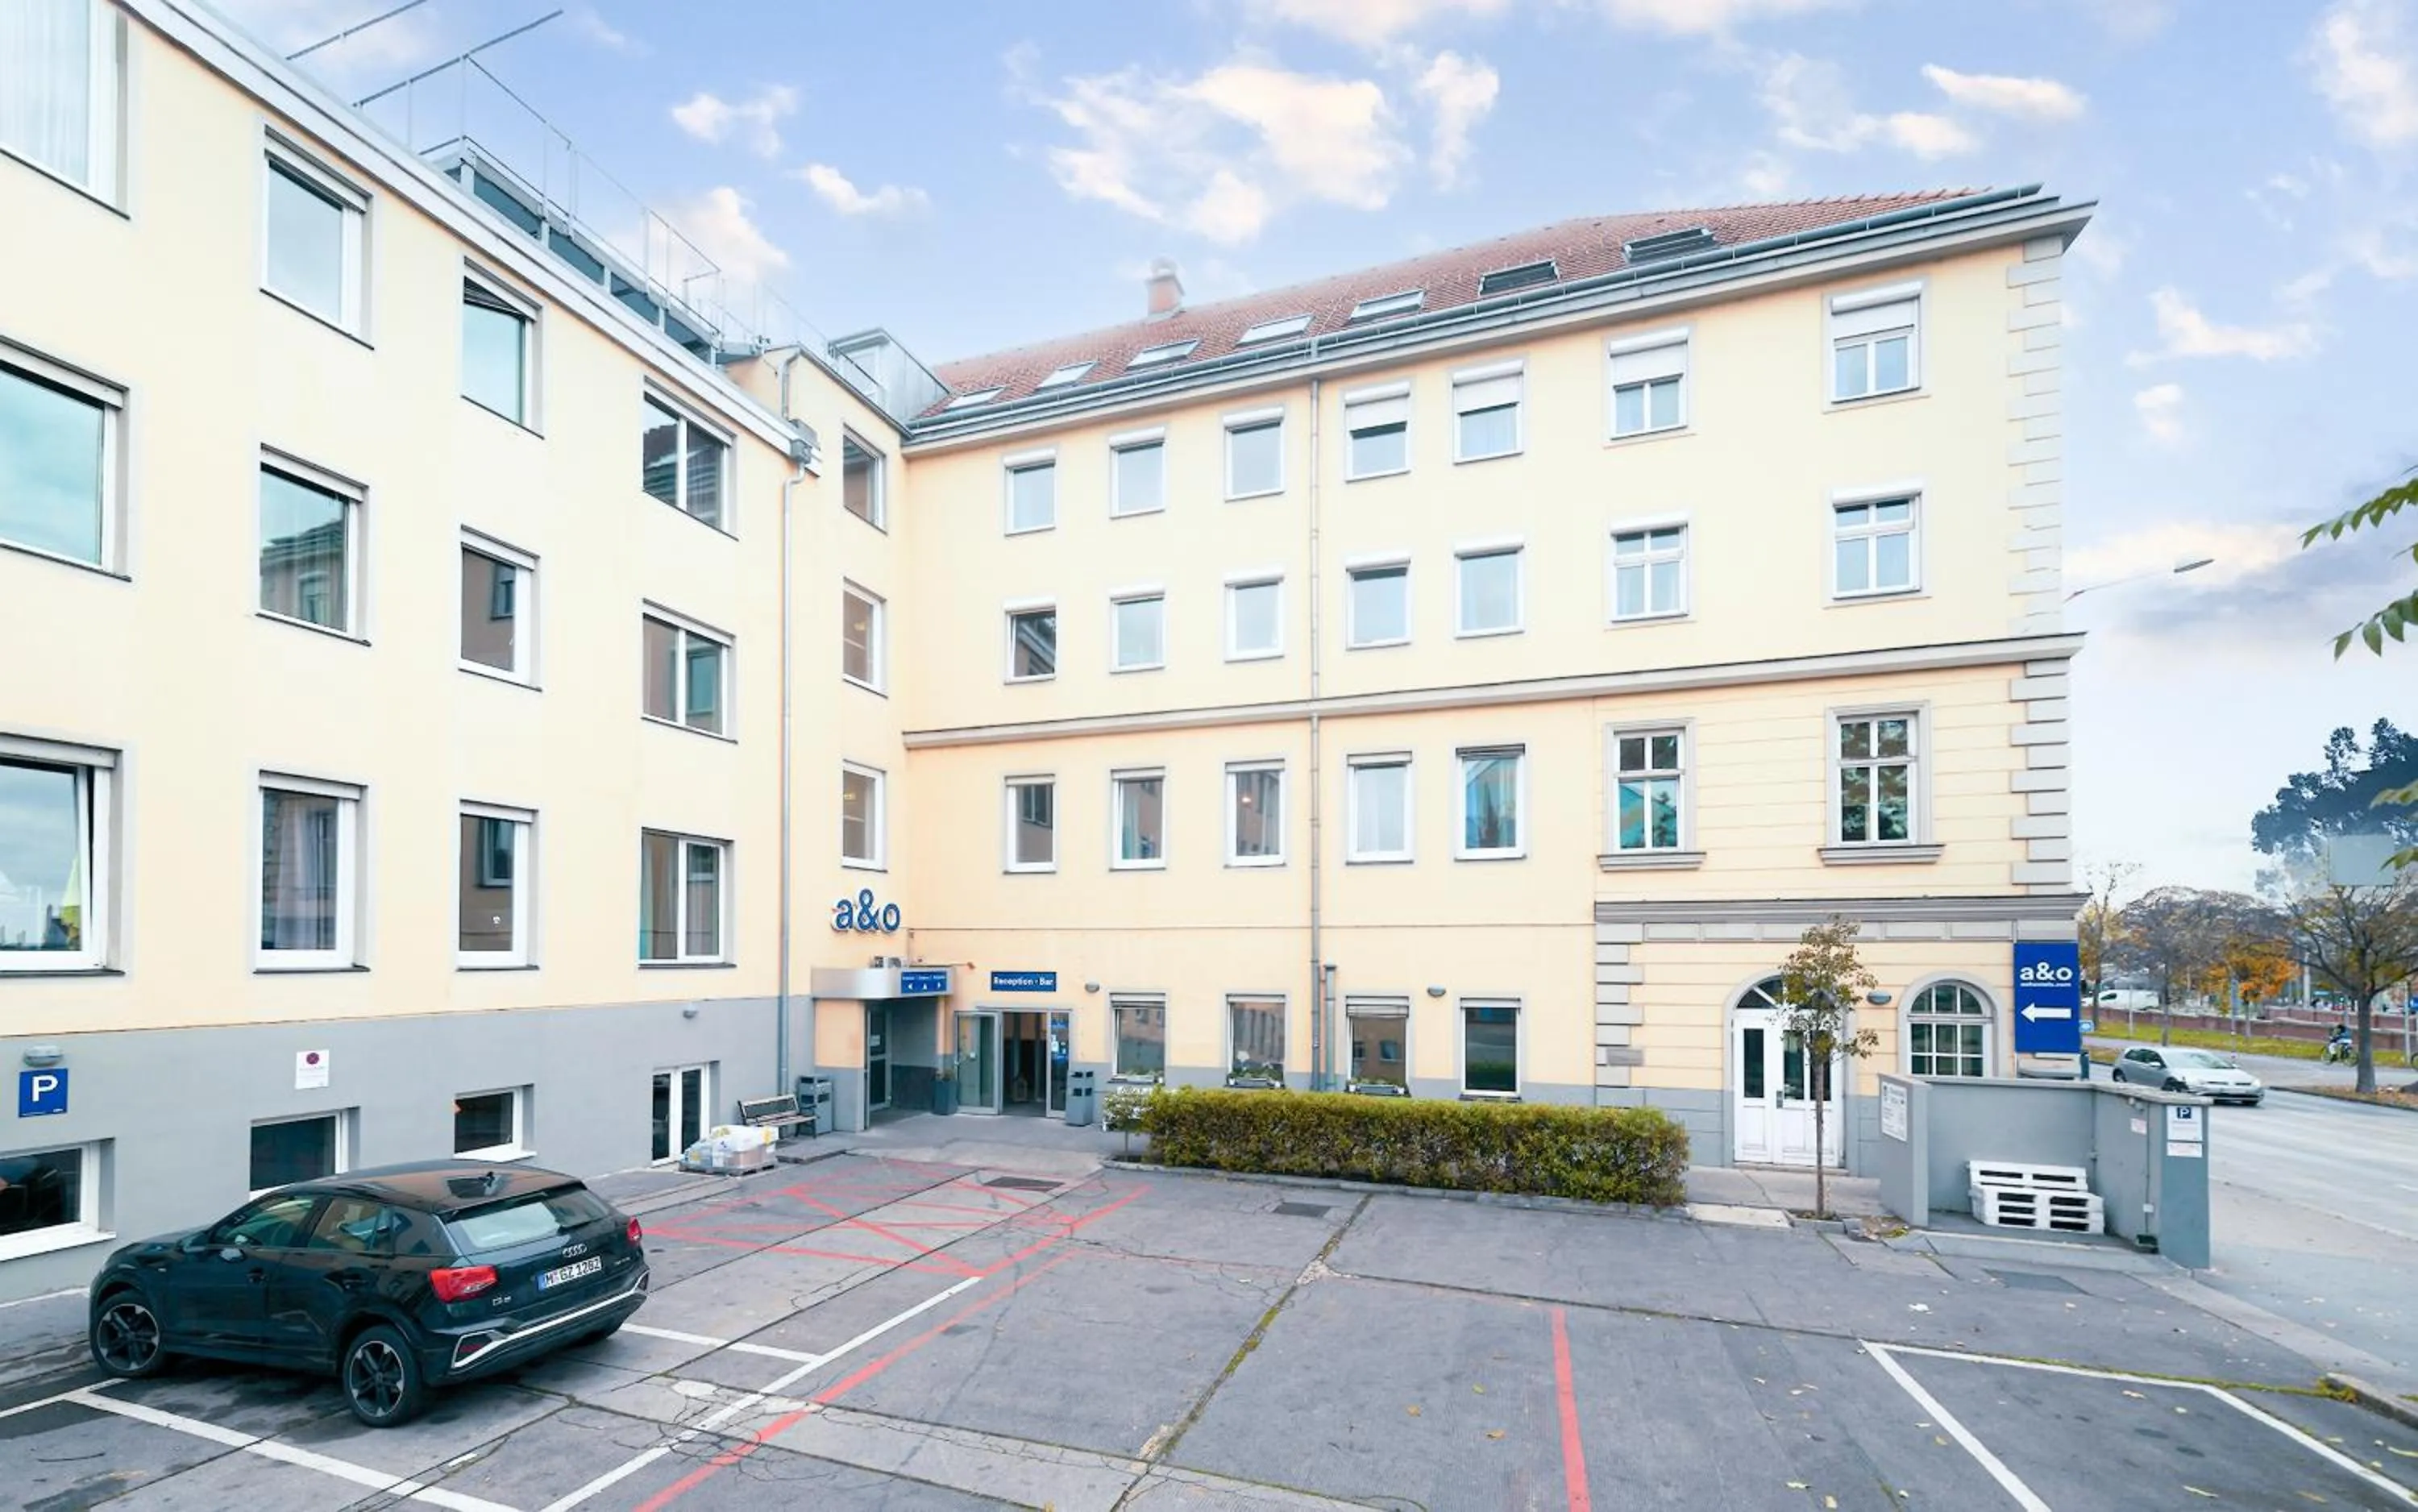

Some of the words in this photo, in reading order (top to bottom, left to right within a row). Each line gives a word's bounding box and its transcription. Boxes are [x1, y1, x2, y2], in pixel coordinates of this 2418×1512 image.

[835, 888, 900, 931] a&o
[993, 976, 1034, 987] Reception
[1039, 977, 1053, 986] Bar
[2020, 962, 2073, 981] a&o
[32, 1074, 58, 1102] P
